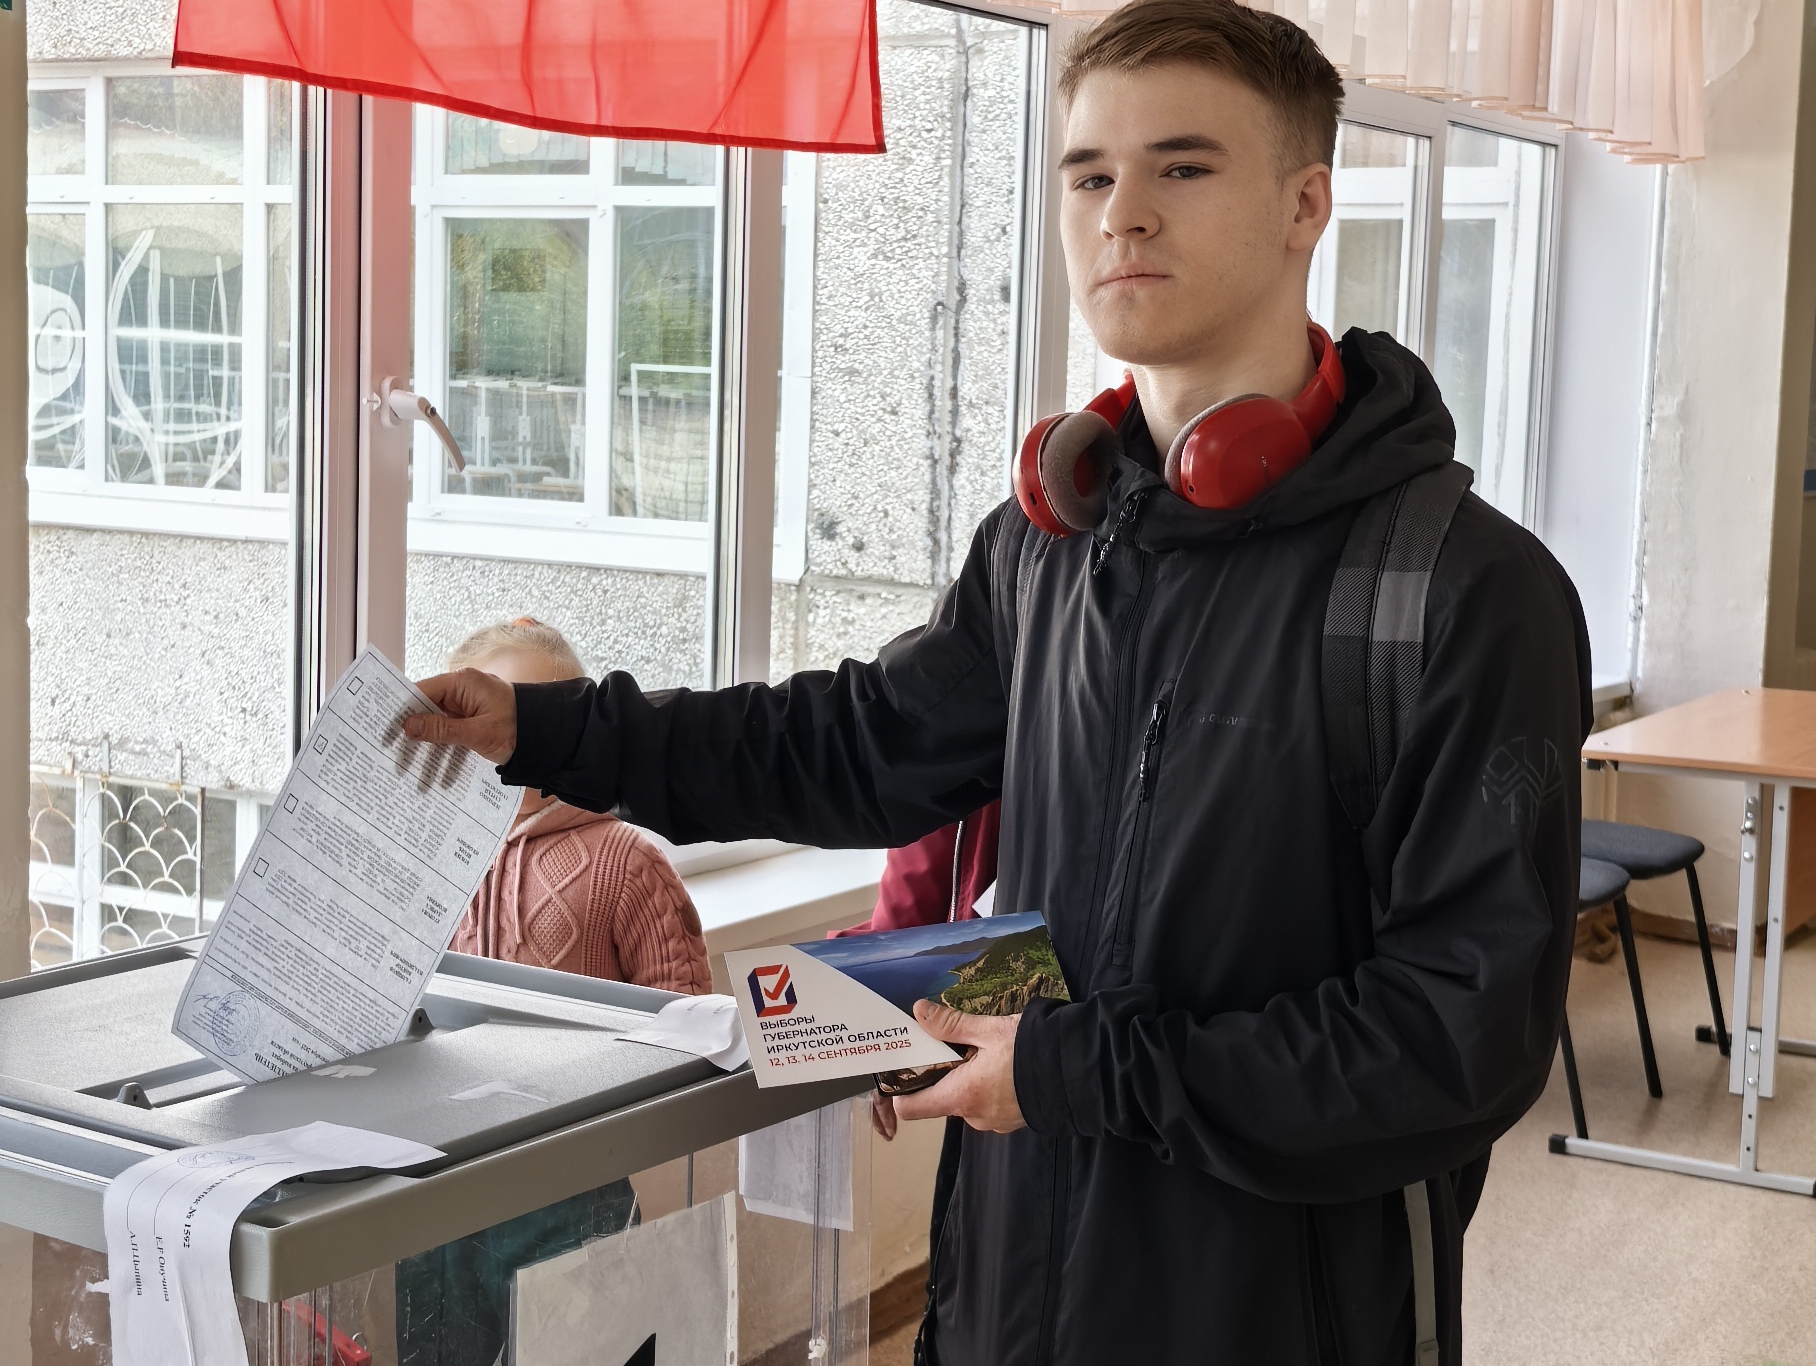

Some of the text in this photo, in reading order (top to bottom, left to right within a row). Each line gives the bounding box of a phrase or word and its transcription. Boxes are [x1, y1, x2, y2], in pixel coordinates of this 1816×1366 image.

[760, 1015, 815, 1031] ВЫБОРЫ
[763, 1023, 848, 1042] ГУБЕРНАТОРА
[766, 1026, 908, 1054] ИРКУТСКОЙ ОБЛАСТИ
[770, 1058, 784, 1067] 12,
[804, 1053, 815, 1062] 14
[818, 1044, 881, 1060] СЕНТЯБРЯ
[885, 1039, 911, 1051] 2025
